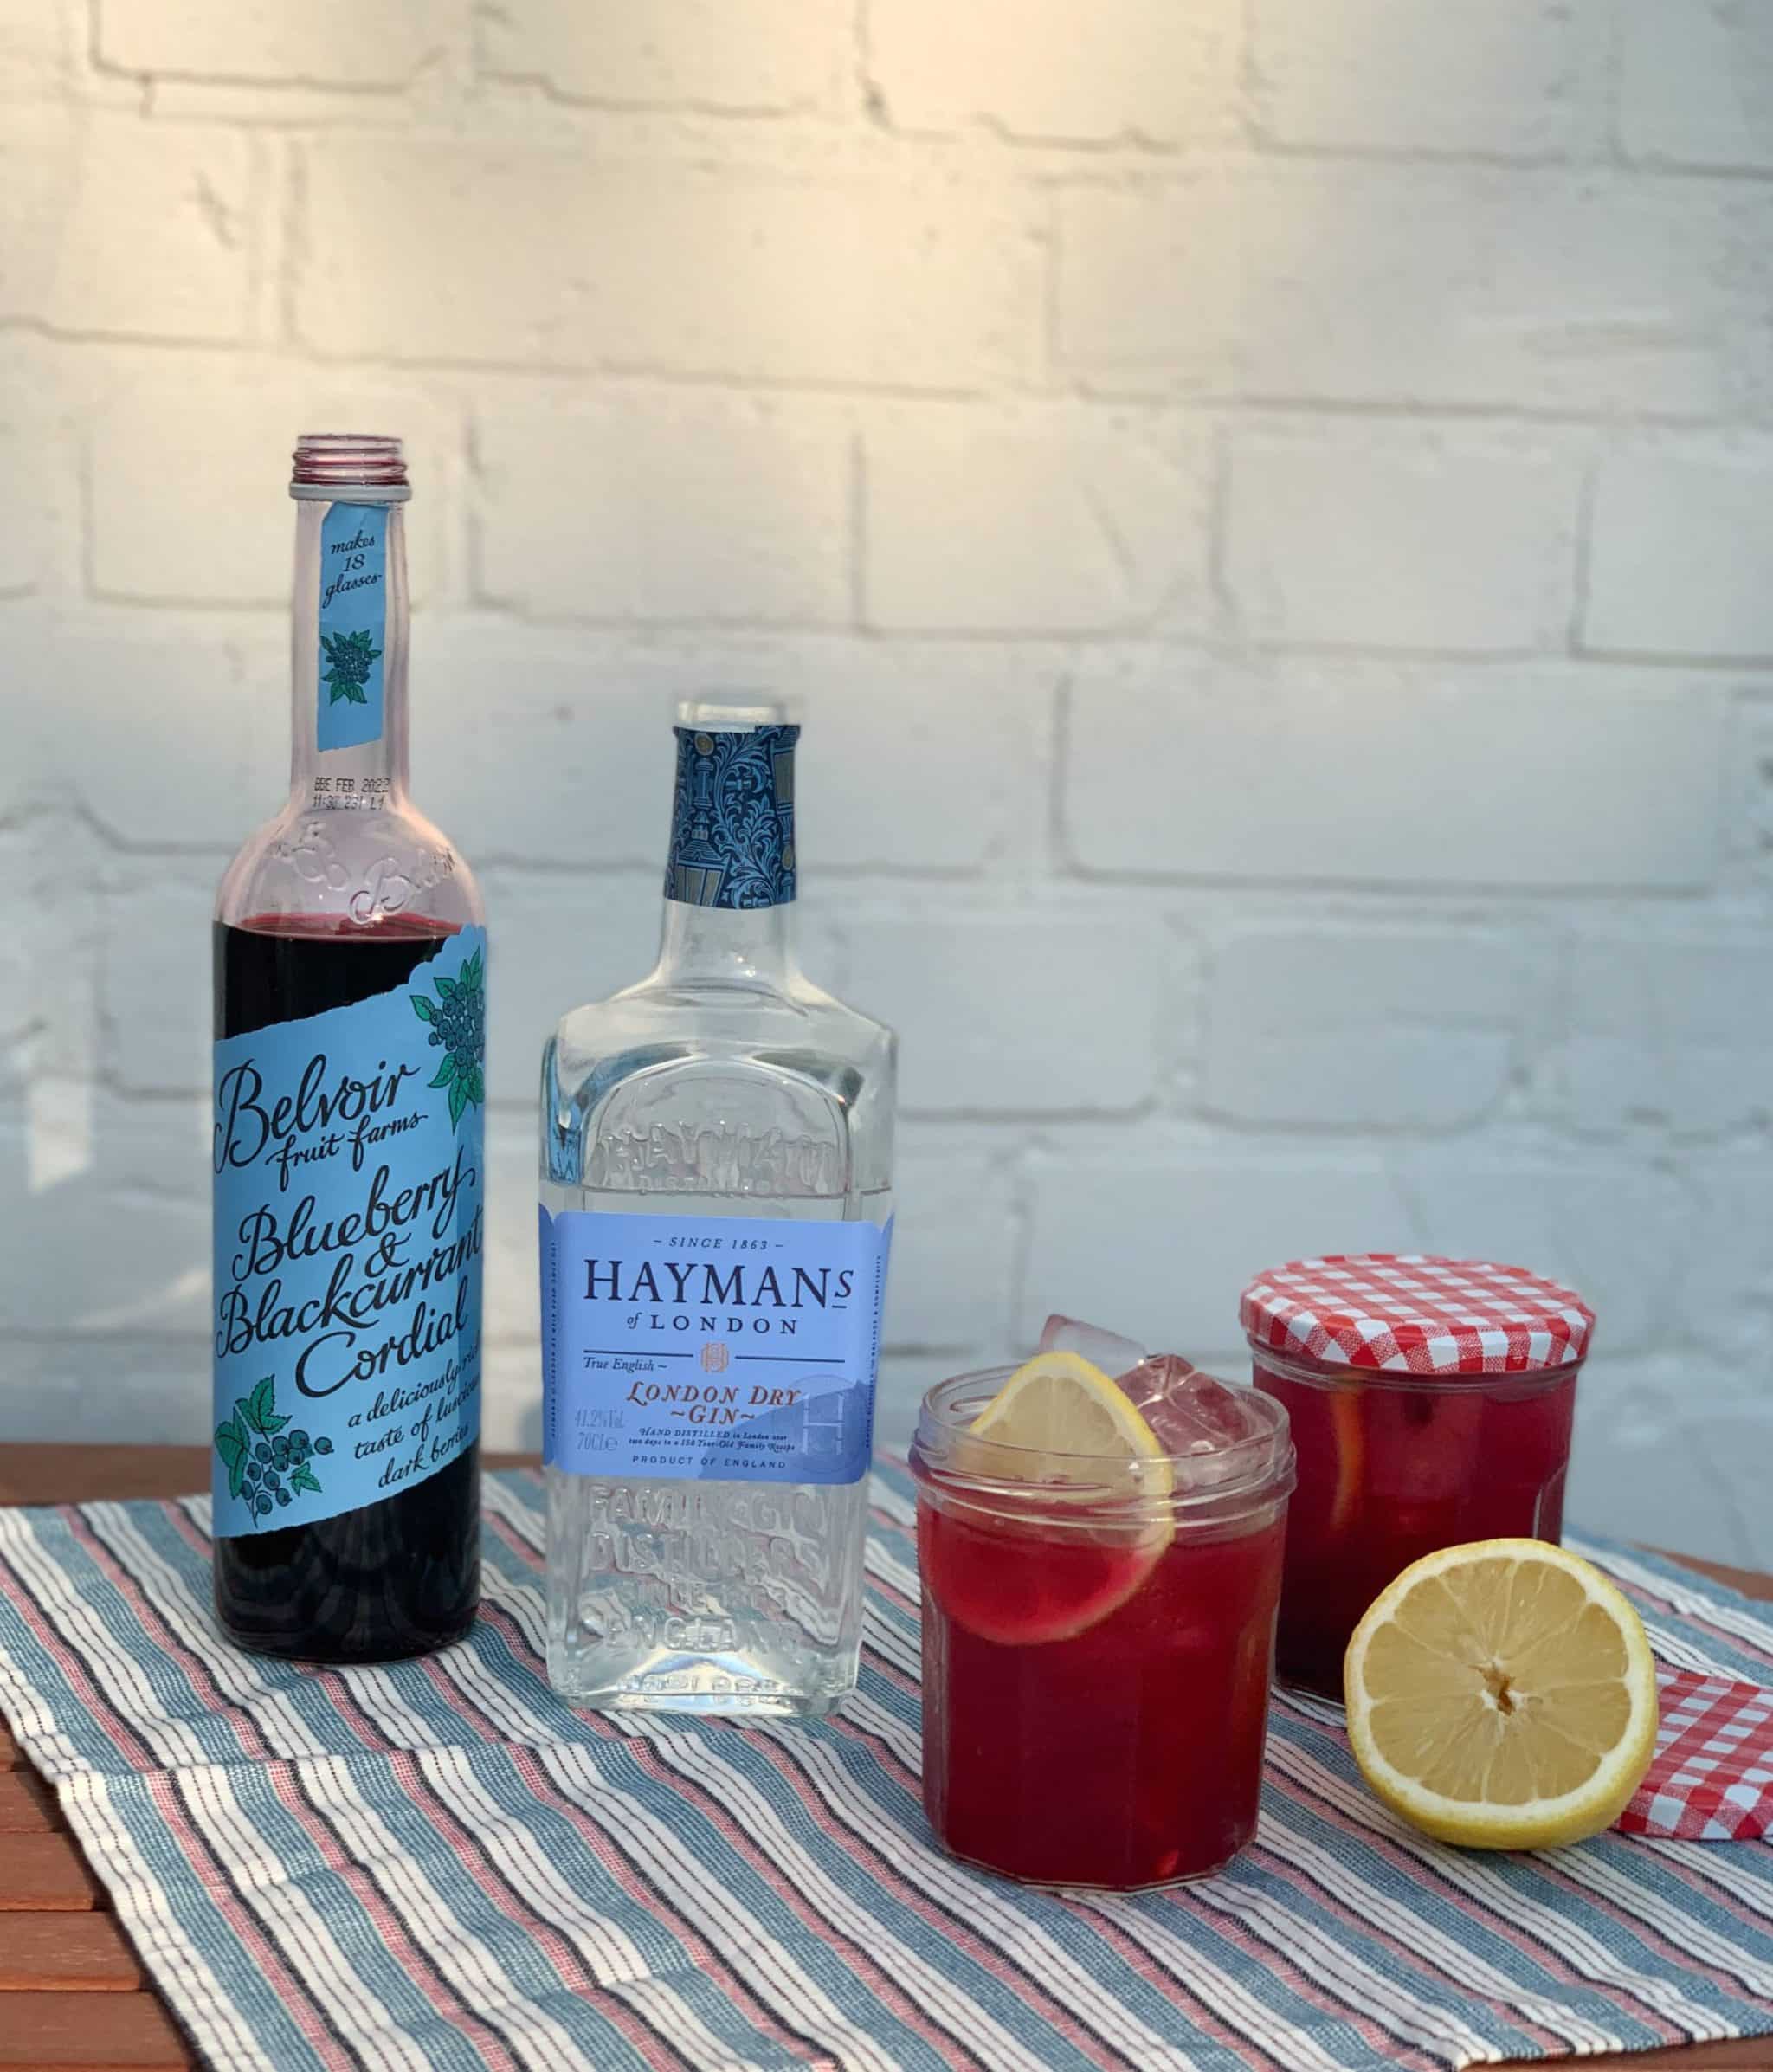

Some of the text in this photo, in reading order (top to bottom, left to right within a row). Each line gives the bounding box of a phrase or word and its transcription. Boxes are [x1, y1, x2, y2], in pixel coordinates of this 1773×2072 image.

[331, 530, 375, 554] makes
[343, 554, 365, 572] 18
[322, 573, 382, 609] glasses
[335, 778, 354, 792] FEB
[214, 1053, 422, 1174] Belvoir
[265, 1110, 429, 1192] fruit farms
[232, 1145, 476, 1282] Blueberry
[364, 1231, 412, 1278] &
[669, 1236, 769, 1250] SINCE 1863
[216, 1204, 483, 1358] Blackcurrant
[295, 1275, 469, 1398] Cordial
[627, 1312, 797, 1335] of LONDON
[583, 1356, 654, 1373] True English
[347, 1413, 362, 1428] a
[366, 1359, 461, 1423] deliciously
[626, 1380, 802, 1407] LONDON DRY
[354, 1425, 404, 1459] taste
[410, 1403, 433, 1442] of
[639, 1427, 671, 1436] HAND
[674, 1429, 731, 1438] DISTILLED
[378, 1443, 429, 1488] dark
[632, 1455, 786, 1469] PRODUCT OF ENGLAND
